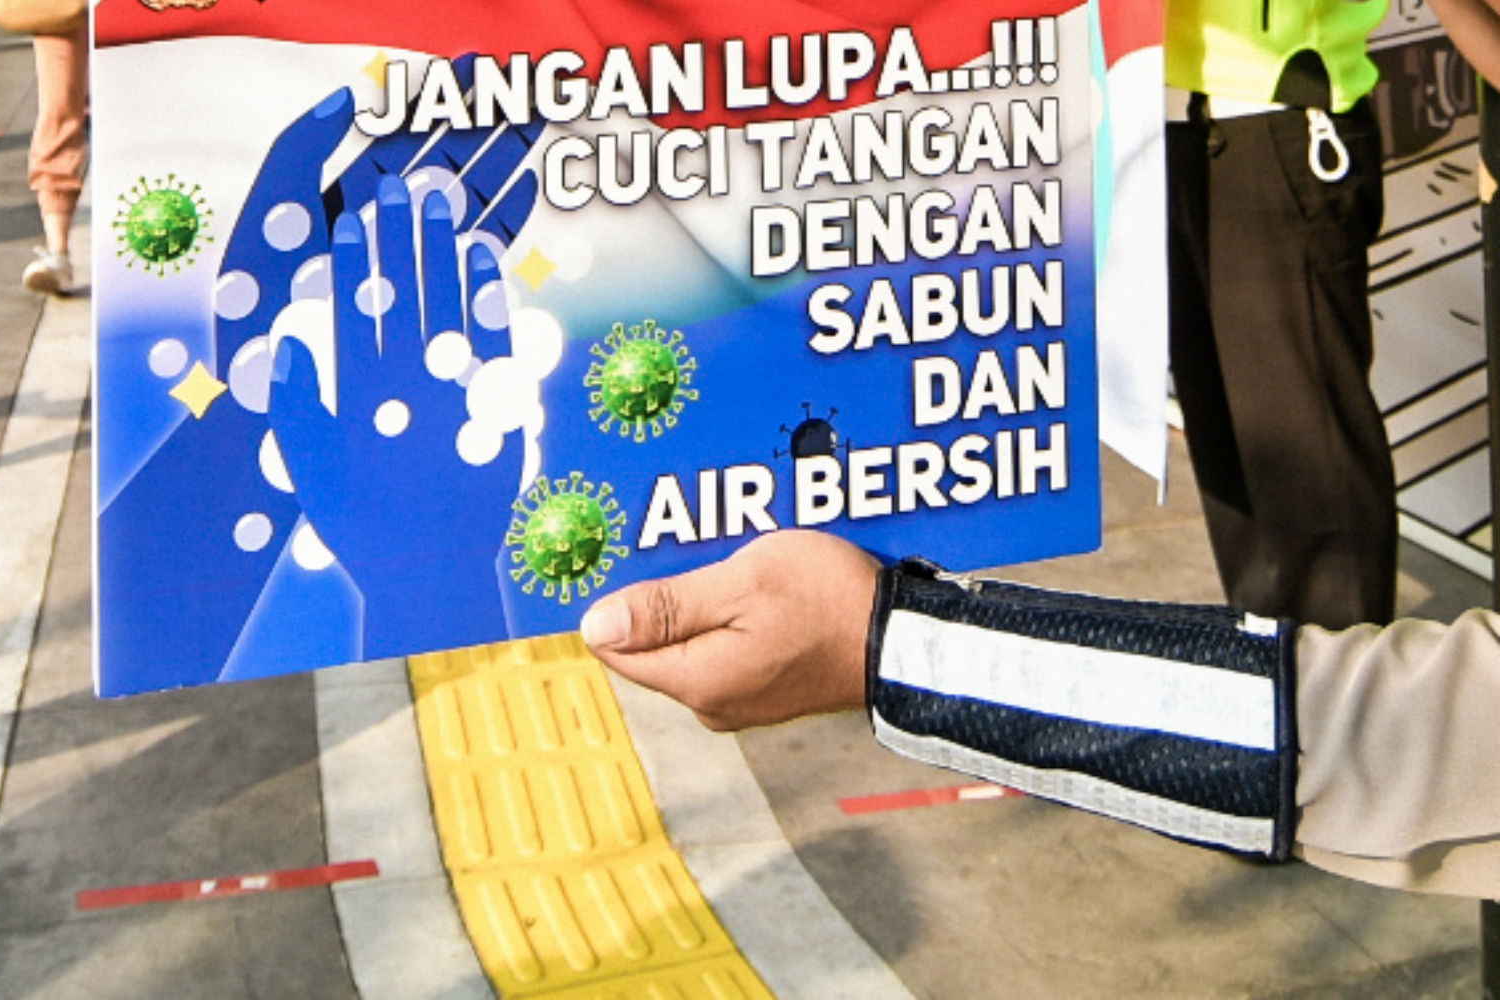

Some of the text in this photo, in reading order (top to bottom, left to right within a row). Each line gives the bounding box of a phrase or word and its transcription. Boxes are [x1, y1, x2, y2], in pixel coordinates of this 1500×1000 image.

[354, 15, 1059, 138] JANGAN LUPA...!!!
[544, 97, 1061, 211] CUCI TANGAN
[751, 179, 1063, 278] DENGAN
[807, 260, 1065, 354] SABUN
[912, 340, 1067, 427] DAN
[637, 422, 1069, 550] AIR BERSIH
